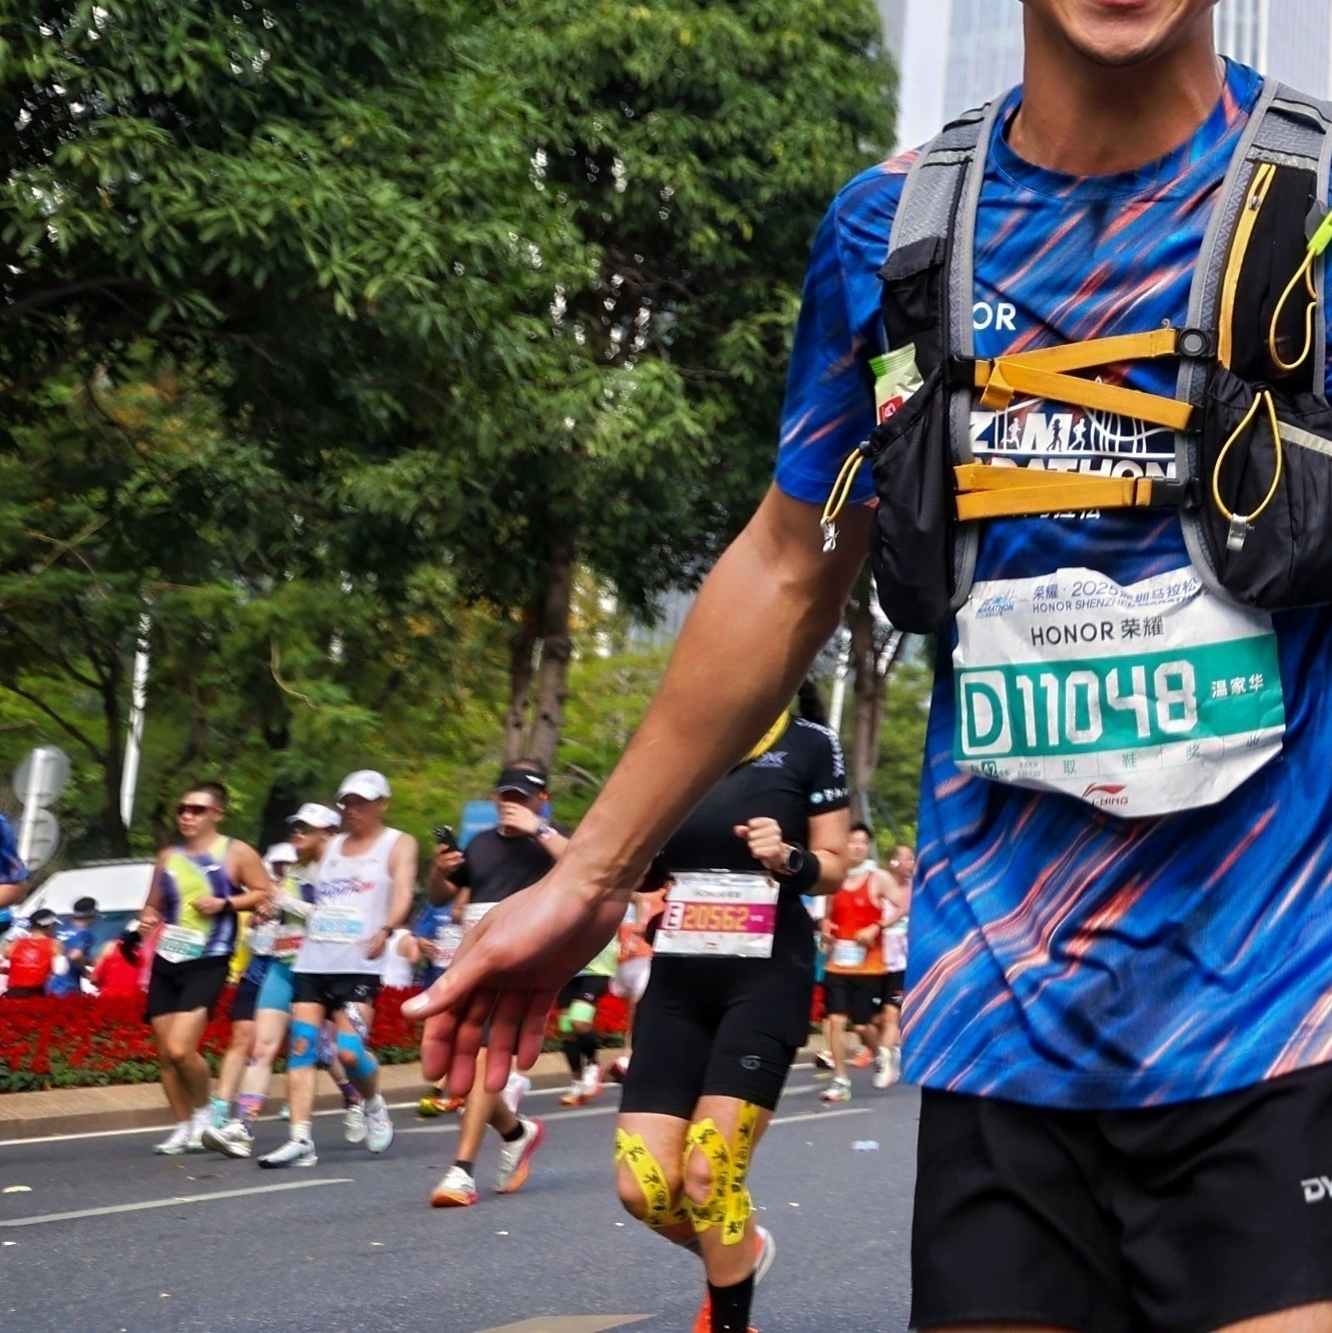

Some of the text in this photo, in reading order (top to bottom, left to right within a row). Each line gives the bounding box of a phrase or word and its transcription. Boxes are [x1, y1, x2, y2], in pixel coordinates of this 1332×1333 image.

[1033, 600, 1072, 613] HONOR
[1031, 615, 1164, 646] HONOR 荣耀
[1211, 673, 1264, 699] 温家华
[1063, 759, 1077, 776] 取
